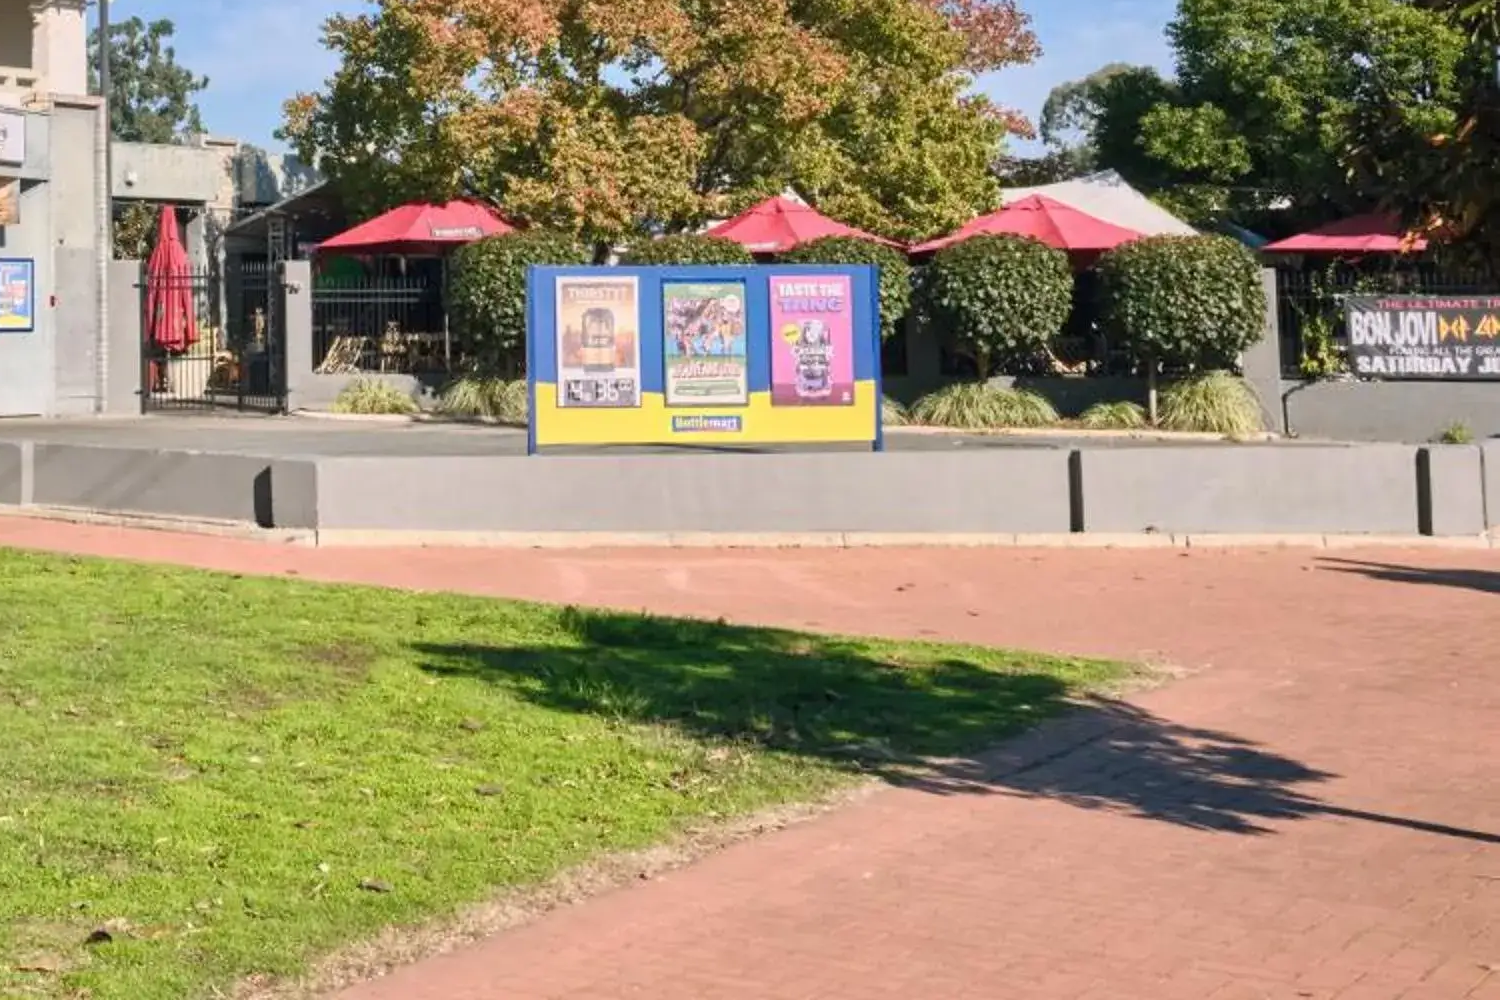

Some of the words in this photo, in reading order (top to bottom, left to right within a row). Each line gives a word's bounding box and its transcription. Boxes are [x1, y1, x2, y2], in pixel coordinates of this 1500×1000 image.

[1378, 299, 1403, 309] THE
[1407, 299, 1478, 309] ULTIMATE
[1350, 311, 1393, 345] BON
[1394, 311, 1438, 346] JOVI
[1356, 355, 1472, 373] SATURDAY
[675, 415, 738, 430] Bottlemart
